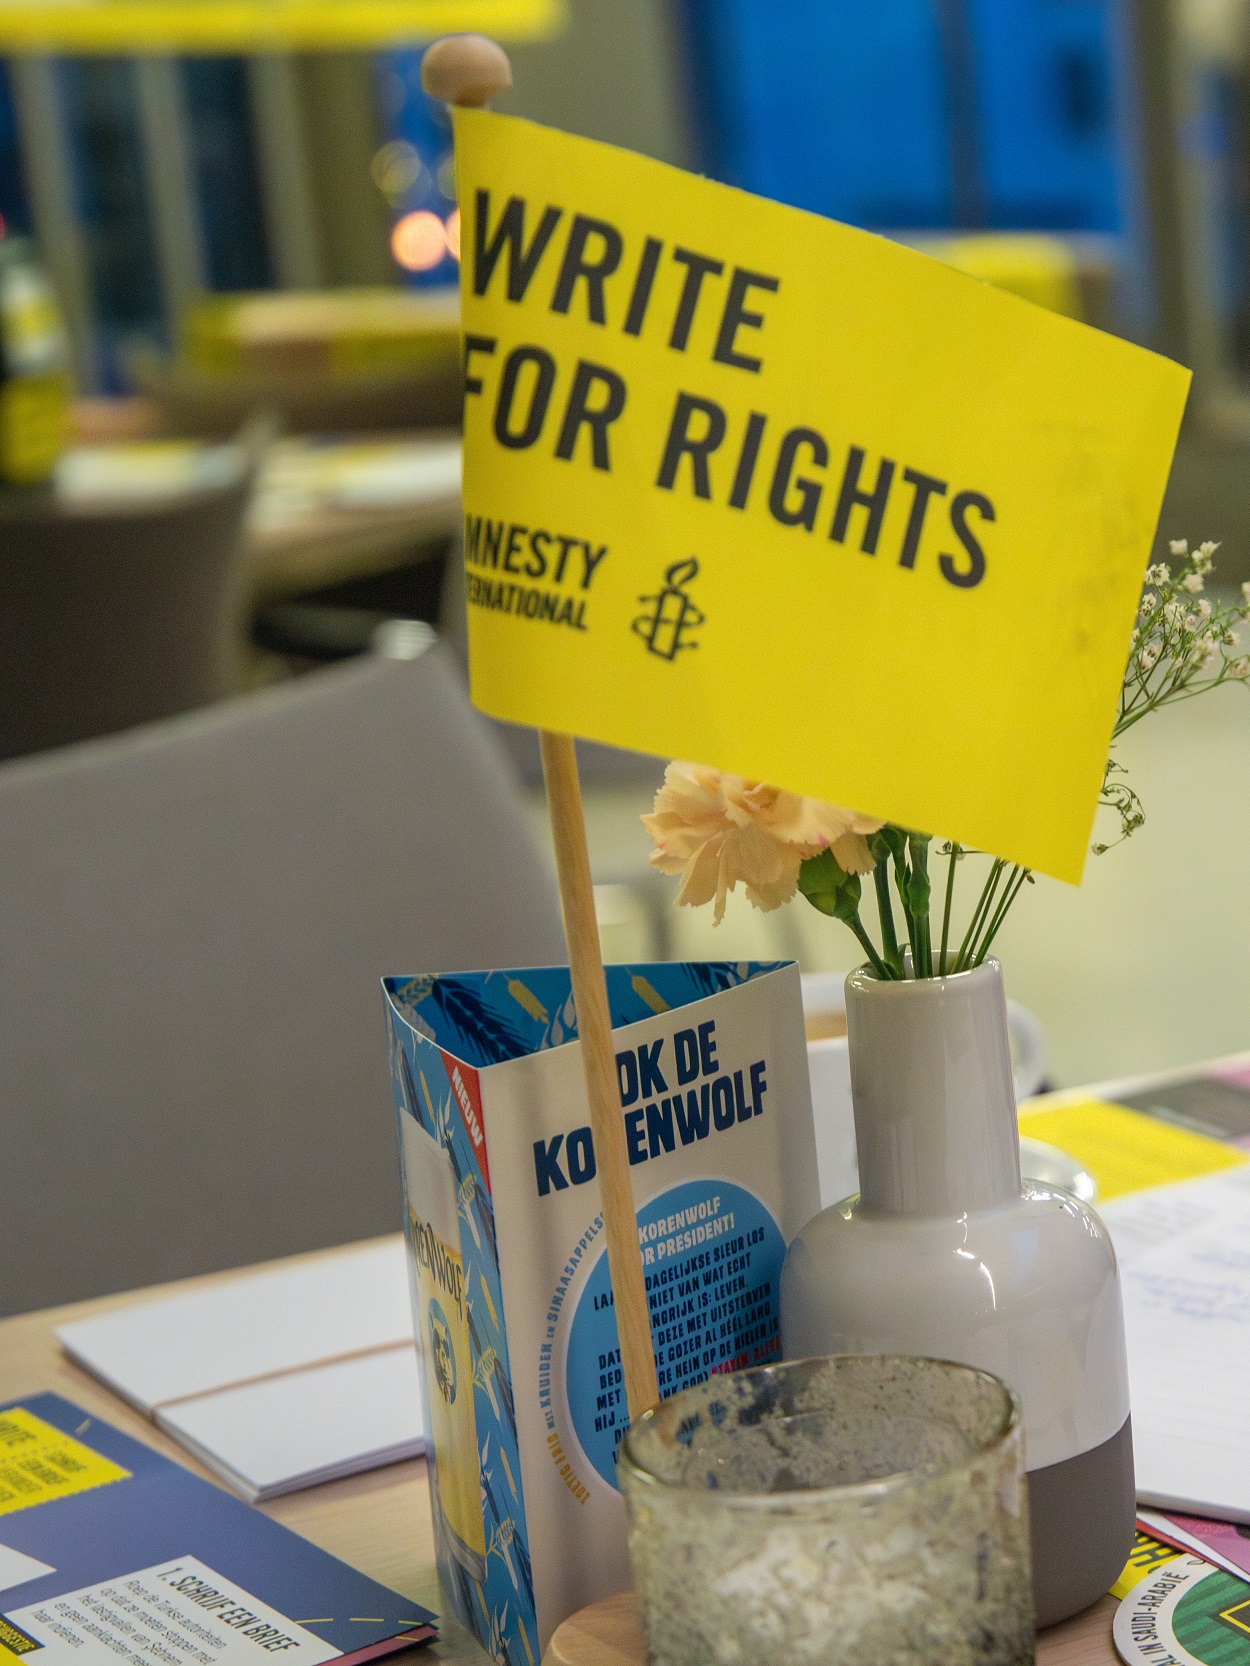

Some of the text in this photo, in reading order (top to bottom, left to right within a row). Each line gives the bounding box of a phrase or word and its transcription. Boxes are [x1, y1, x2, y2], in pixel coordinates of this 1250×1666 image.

[472, 188, 780, 375] WRITE
[463, 332, 997, 592] FOR RIGHTS
[465, 513, 608, 590] MNESTY
[615, 1019, 720, 1108] OK DE
[451, 1064, 483, 1147] NIEUW
[533, 1060, 768, 1198] KOENWOLF
[638, 1196, 721, 1246] KORENWOLF
[657, 1212, 736, 1261] PRESIDENT!
[593, 1290, 614, 1312] LAA
[713, 1239, 745, 1265] SLEUR
[747, 1227, 765, 1248] LOS
[677, 1276, 700, 1298] VAN
[702, 1266, 725, 1288] WAT
[727, 1252, 751, 1277] ECHT
[658, 1322, 684, 1348] DEZE
[686, 1314, 708, 1336] MET
[667, 1336, 702, 1363] GOZER
[705, 1329, 717, 1347] AL
[596, 1388, 621, 1411] MET
[675, 1356, 700, 1380] HEIN
[702, 1347, 717, 1367] OP
[719, 1341, 732, 1358] DE
[594, 1411, 616, 1433] HIJ
[168, 1575, 236, 1612] SCHRIJF
[215, 1606, 262, 1631] EEN
[241, 1623, 301, 1653] BRIEF
[1130, 1570, 1192, 1643] SAUDI-ARABIË
